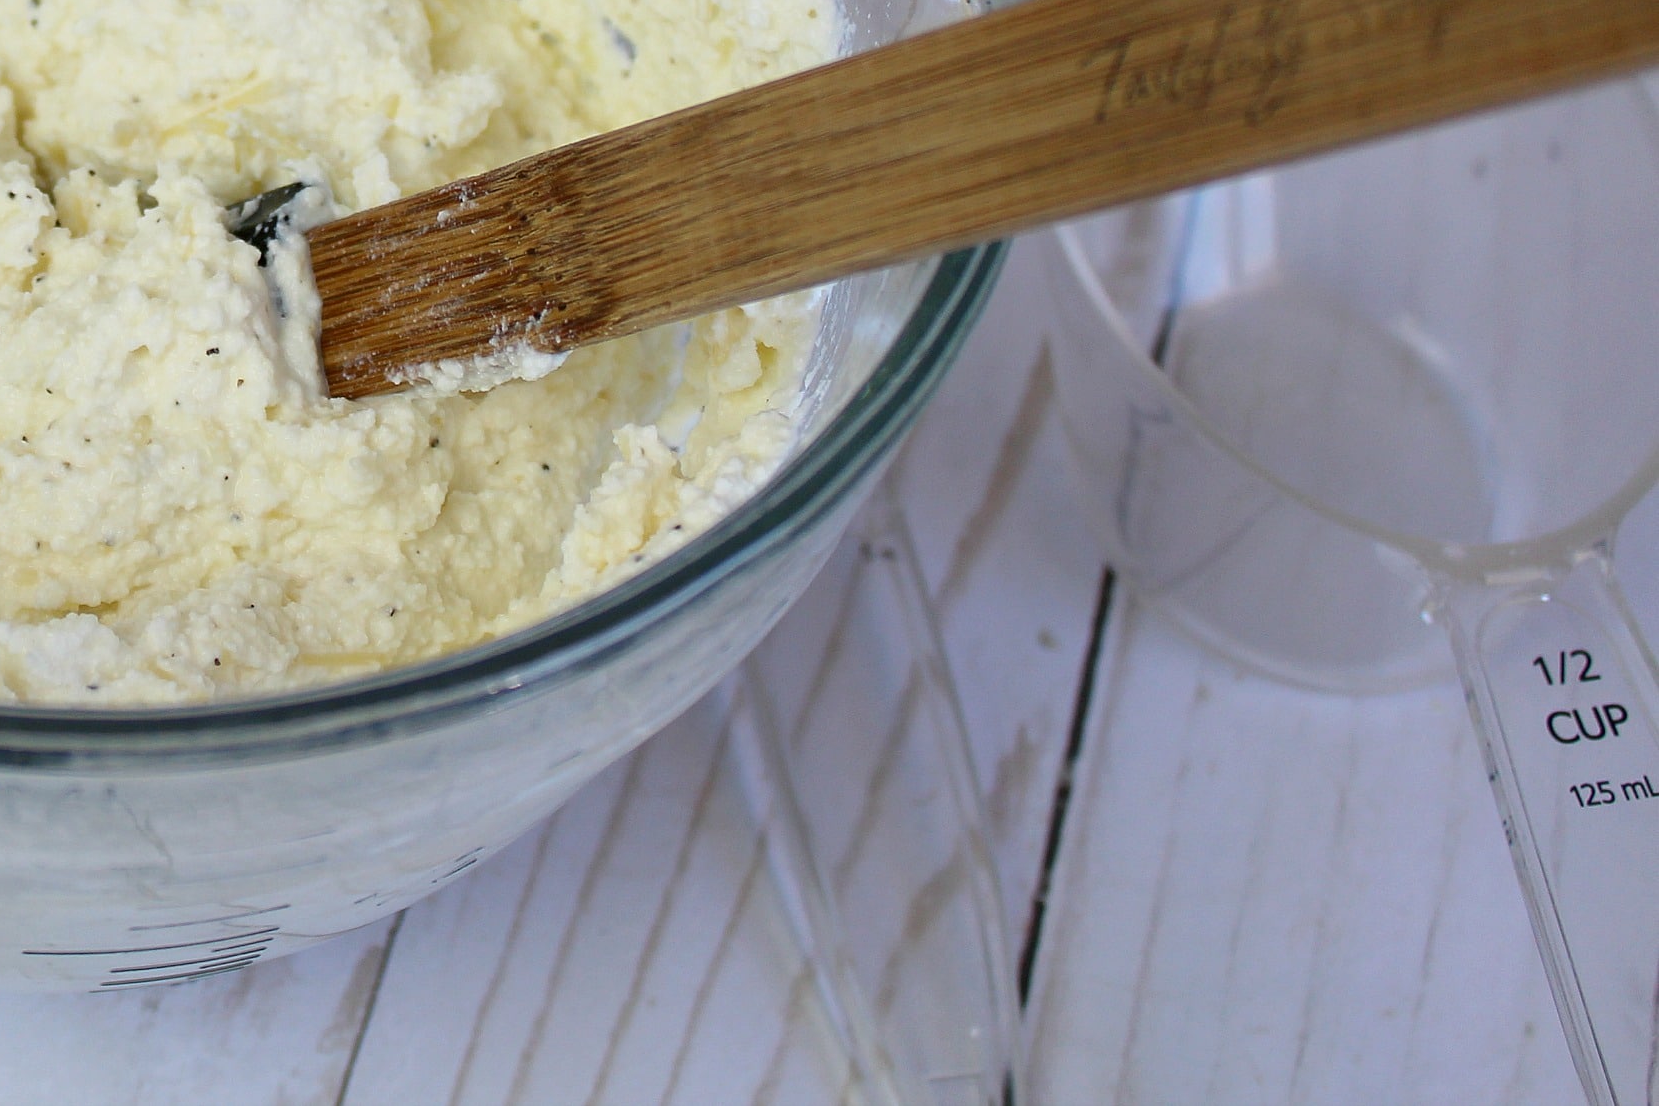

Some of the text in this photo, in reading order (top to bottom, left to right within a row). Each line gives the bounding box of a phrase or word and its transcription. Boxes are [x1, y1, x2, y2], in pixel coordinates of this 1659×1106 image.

[1532, 649, 1601, 687] 1/2
[1545, 702, 1630, 746] CUP
[1569, 773, 1659, 809] 125 mL
